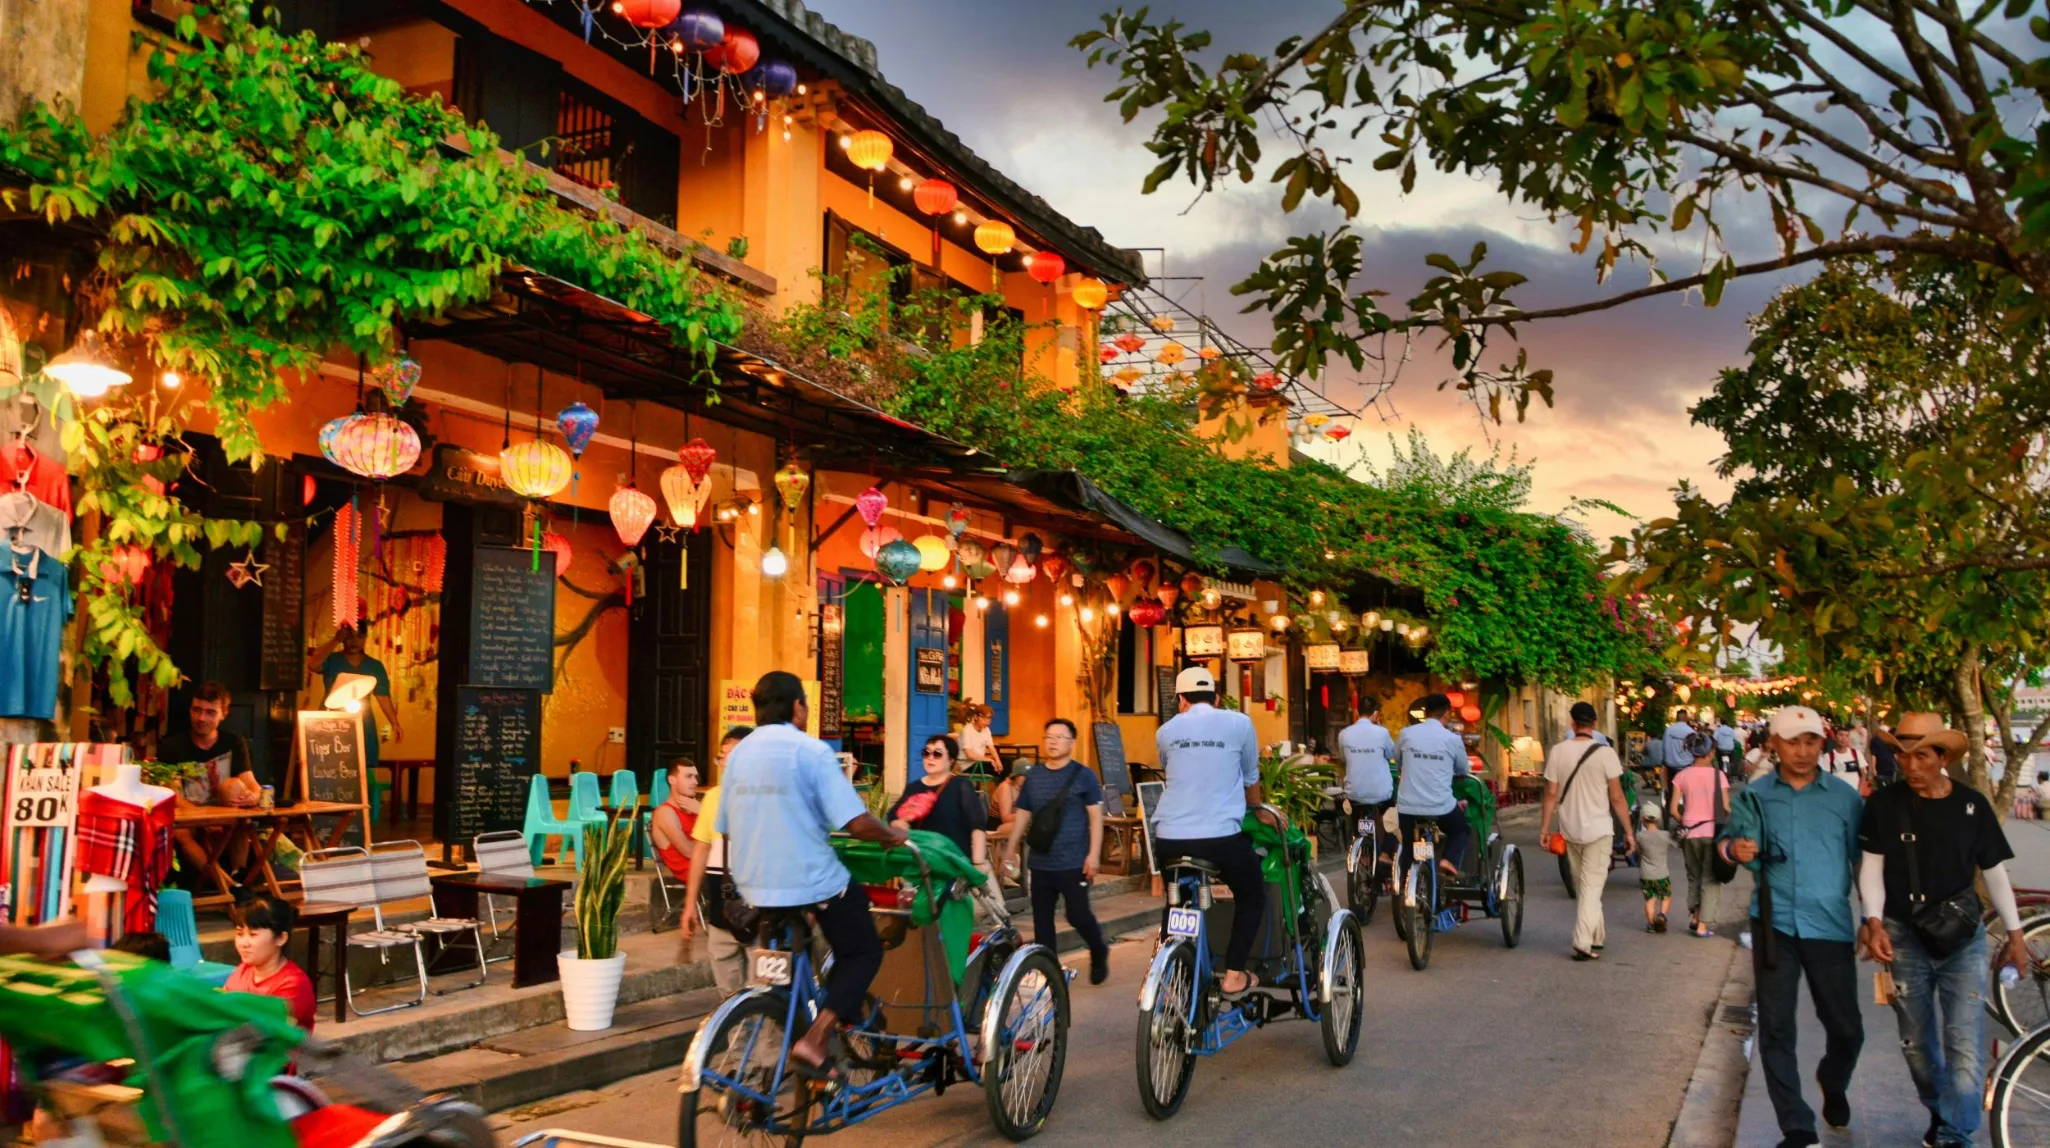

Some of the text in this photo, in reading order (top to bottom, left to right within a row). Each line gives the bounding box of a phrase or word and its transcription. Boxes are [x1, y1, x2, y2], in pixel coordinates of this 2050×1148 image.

[308, 739, 331, 762] Tiger
[46, 775, 72, 792] SALE
[1359, 821, 1373, 832] 067
[1413, 845, 1434, 856] 068
[1170, 913, 1197, 932] 009
[756, 955, 788, 980] 022
